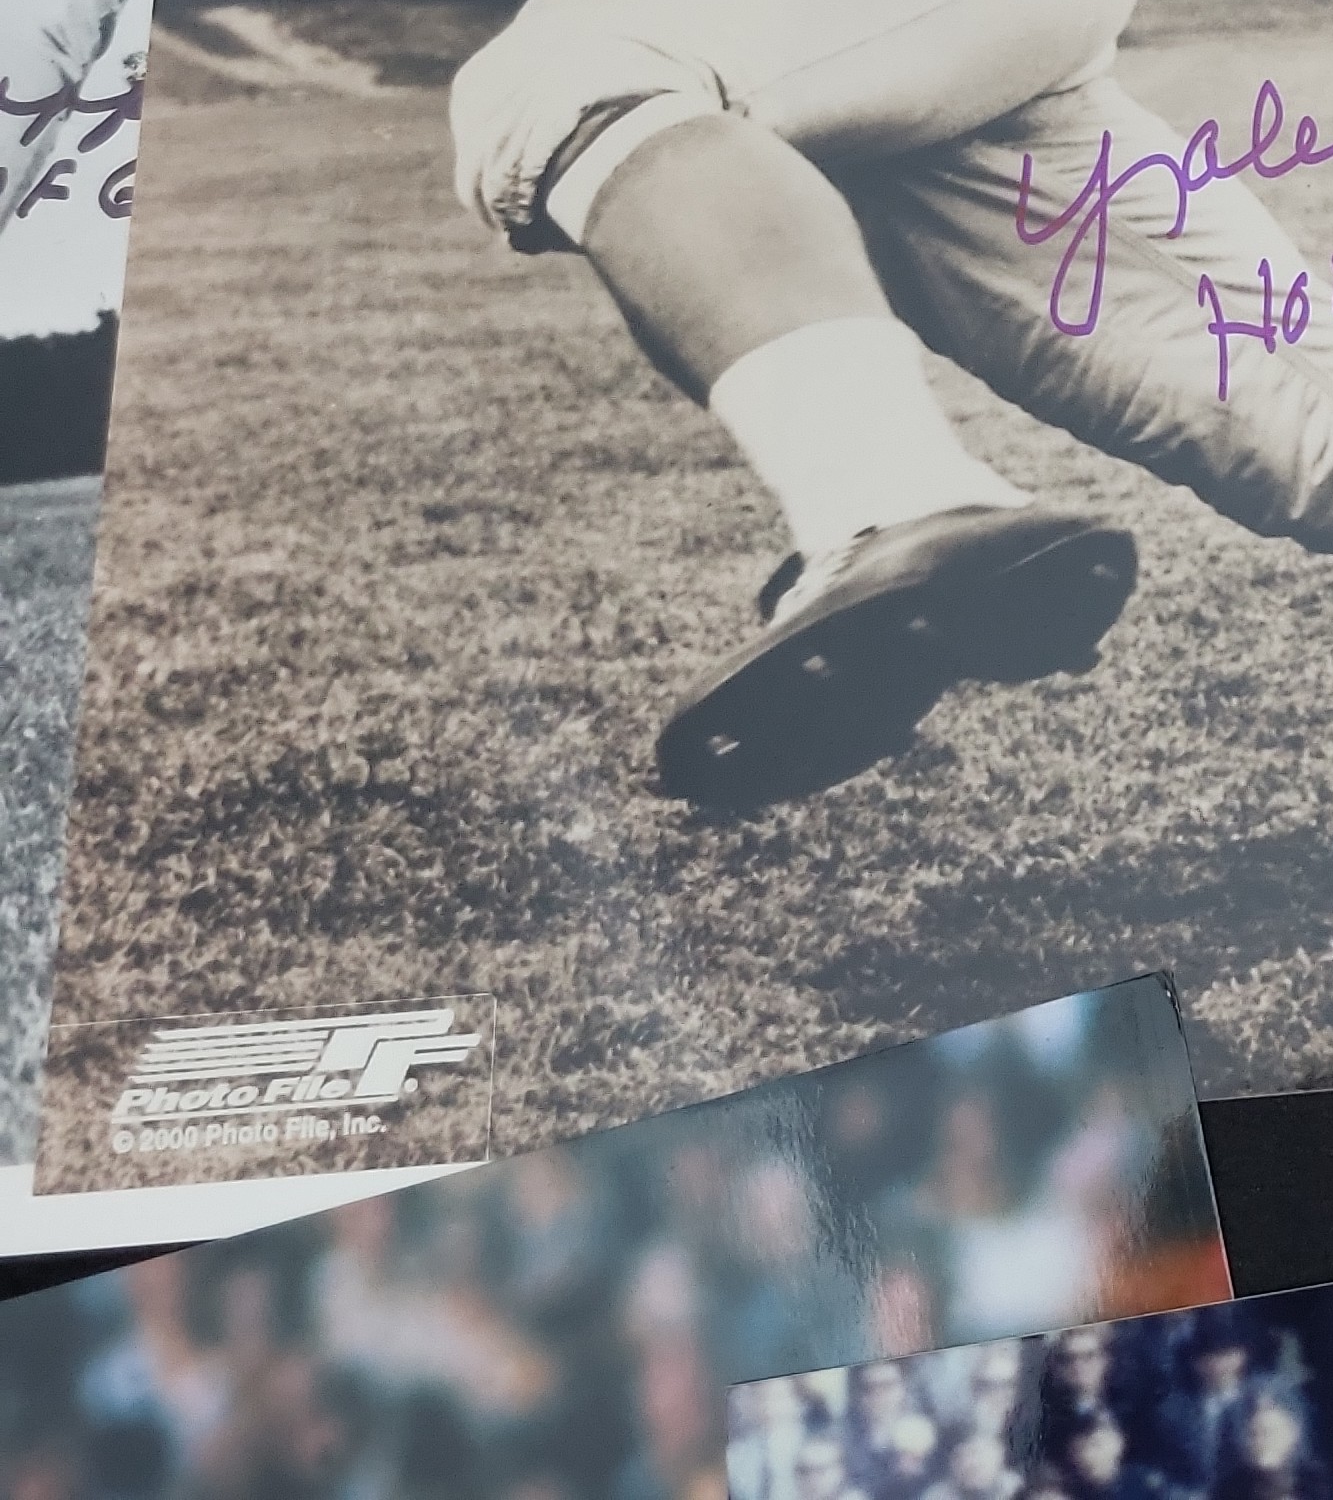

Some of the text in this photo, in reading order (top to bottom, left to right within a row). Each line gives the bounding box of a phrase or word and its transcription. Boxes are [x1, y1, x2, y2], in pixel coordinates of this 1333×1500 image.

[113, 1076, 352, 1117] Photo File
[139, 1126, 198, 1151] 2000
[206, 1121, 277, 1147] Photo
[285, 1115, 337, 1142] File,
[342, 1109, 388, 1135] Inc.
